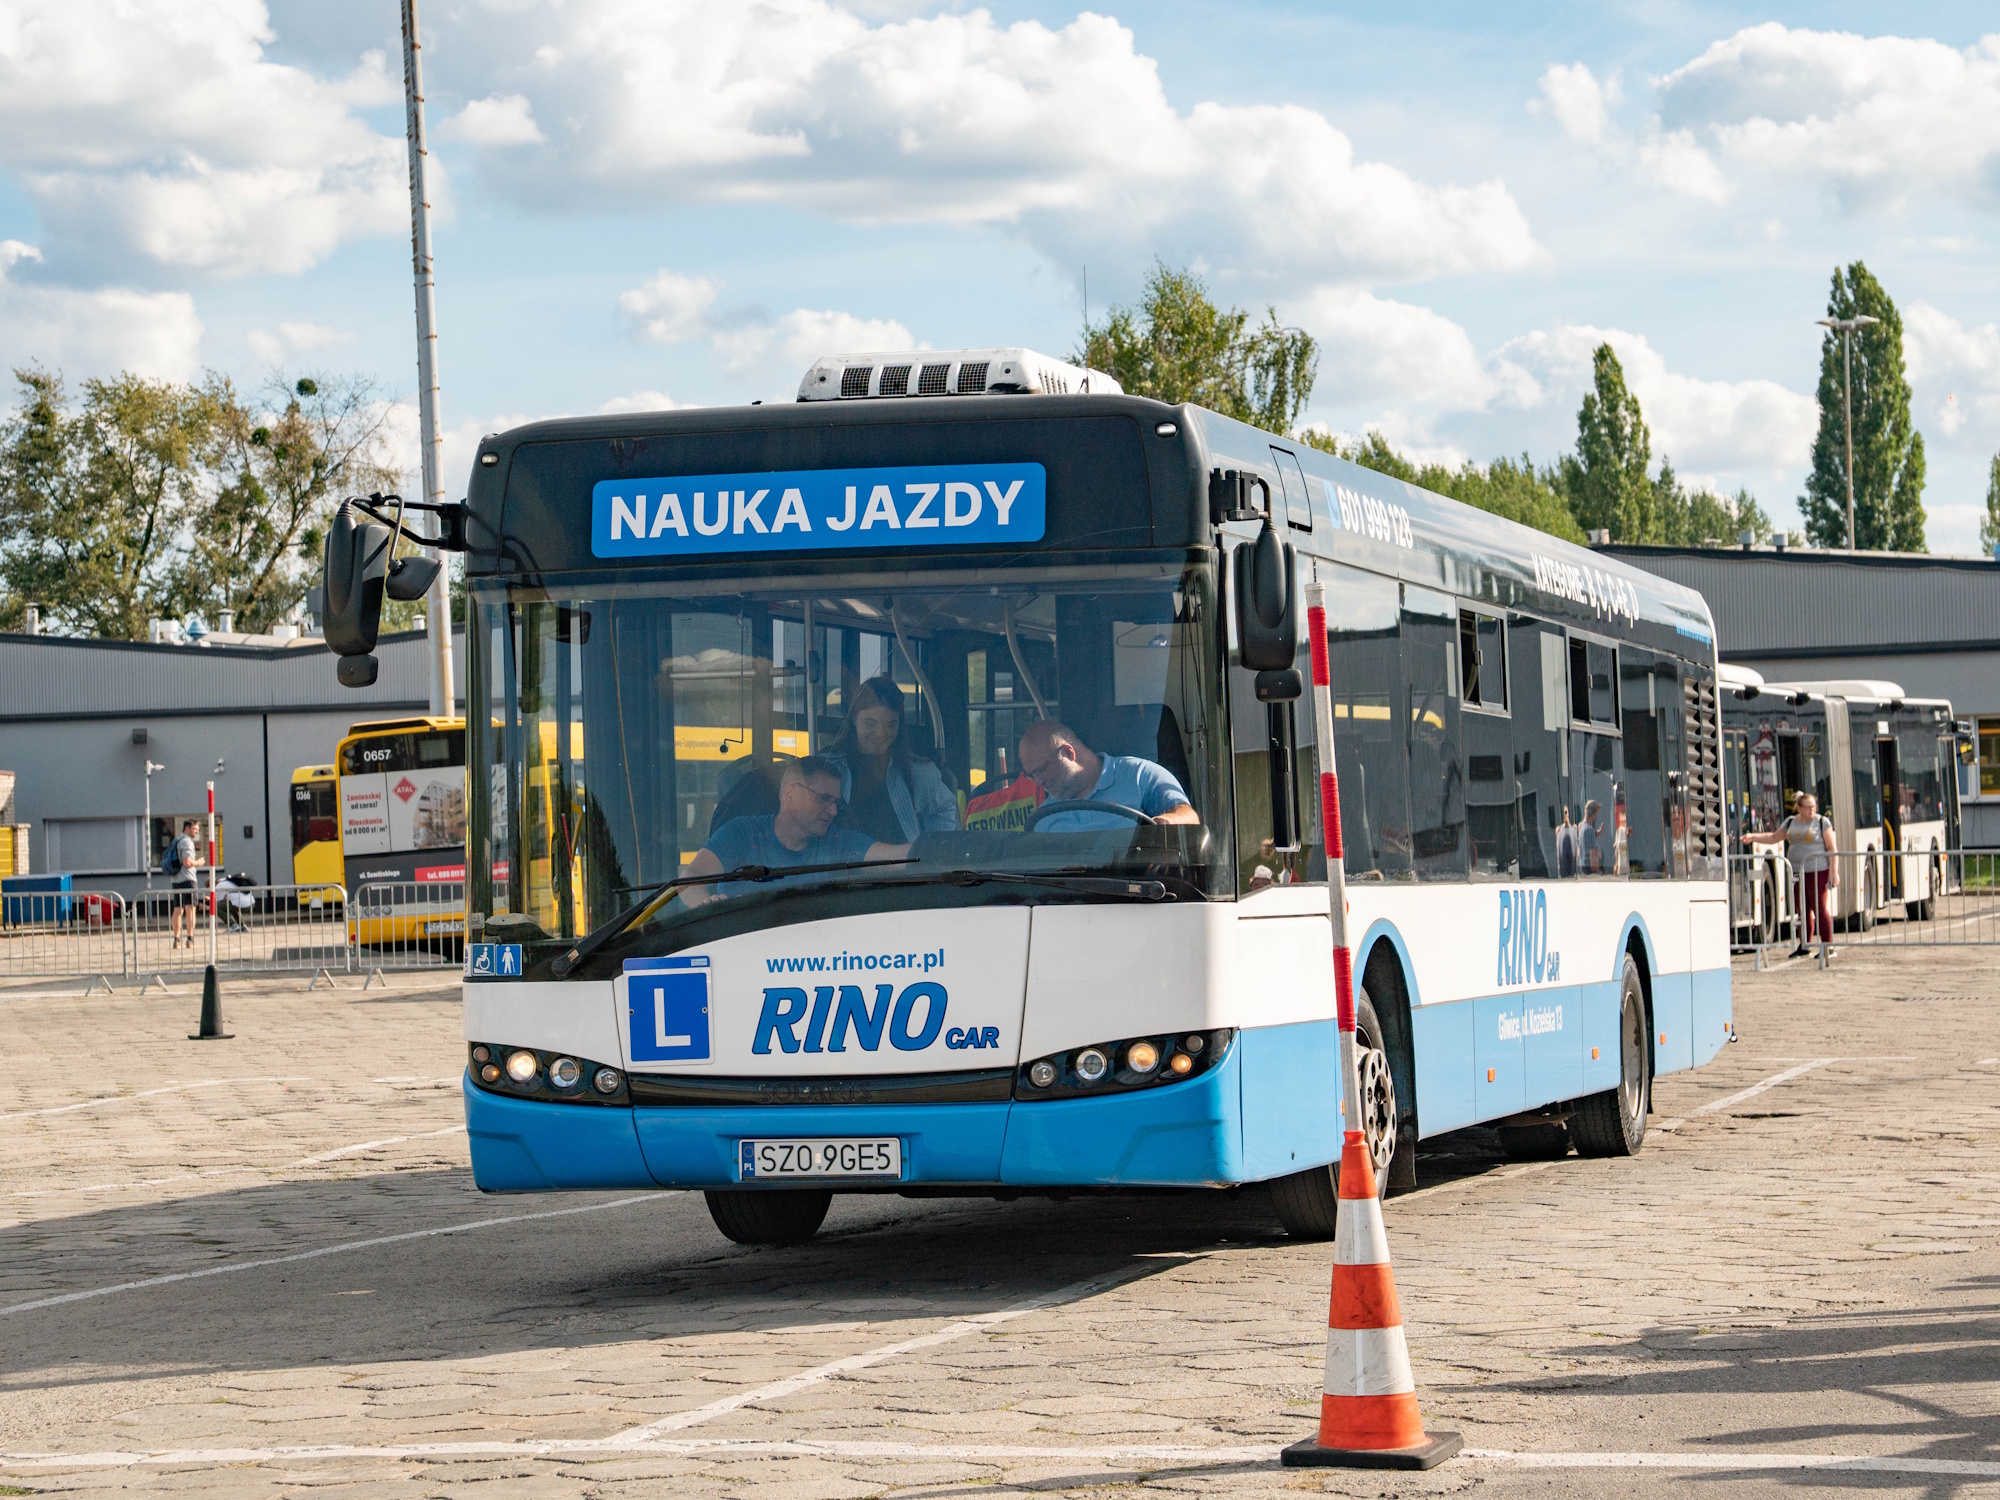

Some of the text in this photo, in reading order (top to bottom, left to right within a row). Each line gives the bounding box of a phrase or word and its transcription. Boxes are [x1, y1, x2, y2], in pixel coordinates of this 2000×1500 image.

[610, 480, 1025, 540] NAUKA JAZDY
[1337, 485, 1414, 549] 601 999 128
[1530, 552, 1587, 605] KATEGORIE:
[363, 749, 391, 762] 0657
[296, 790, 310, 801] 0366
[346, 793, 381, 802] Zamieszkaj
[360, 801, 378, 809] zaraz!
[344, 827, 352, 836] od
[348, 817, 383, 827] Mieszkania
[1497, 888, 1560, 986] RINO CAR
[765, 949, 945, 973] www.rinocar.pl
[653, 988, 691, 1048] L
[751, 981, 1000, 1055] RINO CAR
[1556, 1004, 1562, 1031] 13
[744, 1143, 891, 1172] PL SZO 9GE5
